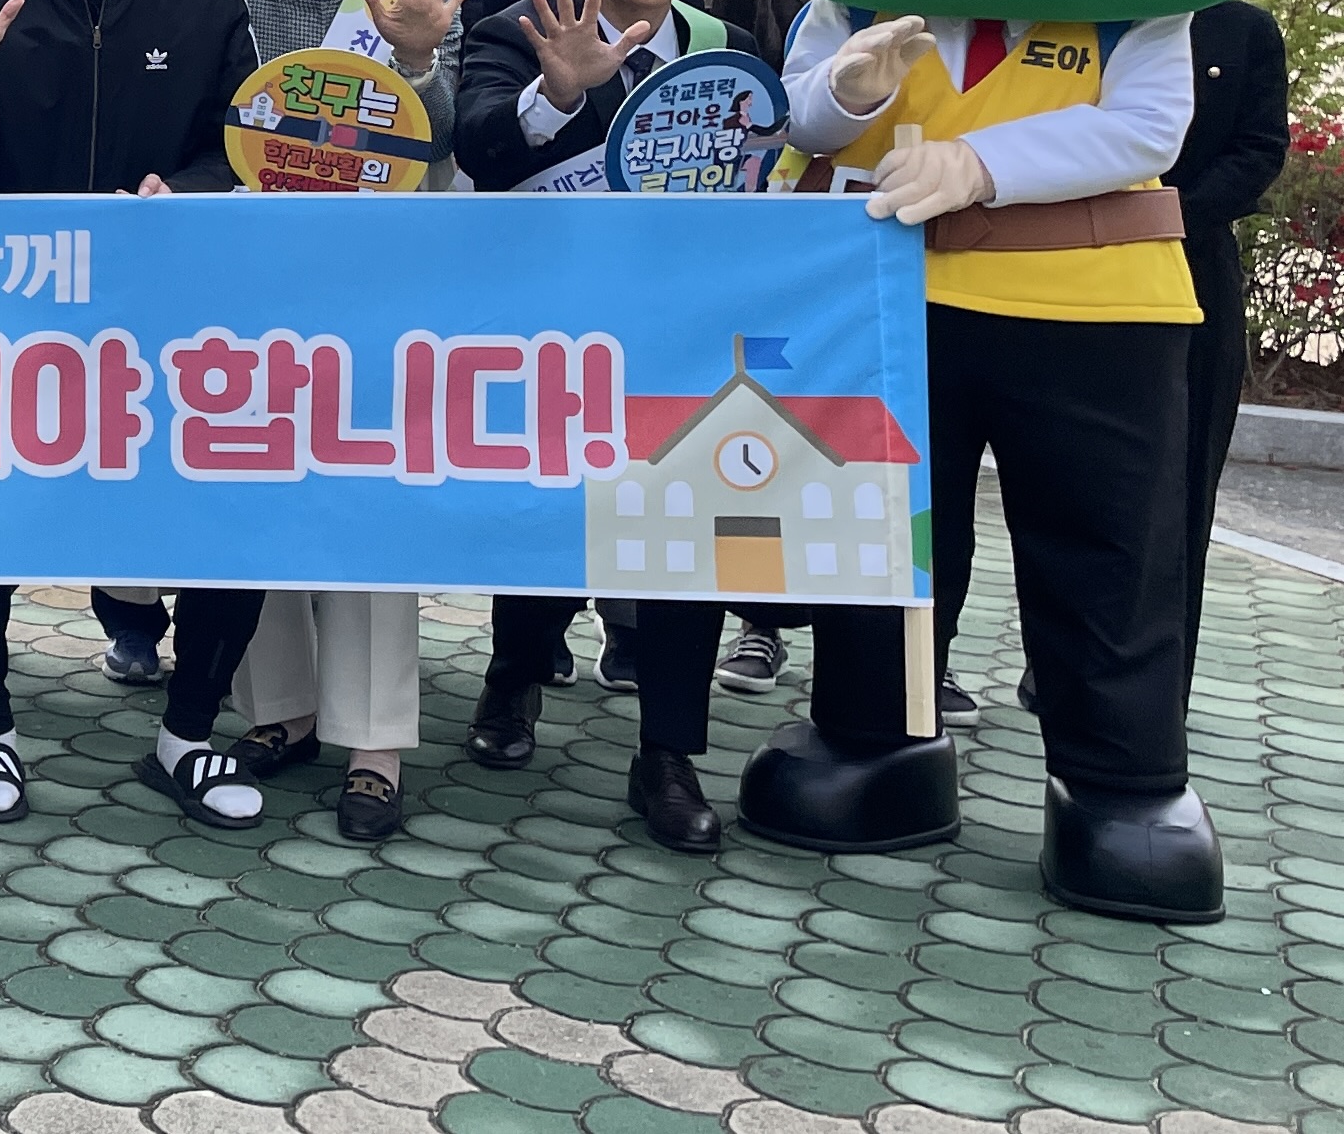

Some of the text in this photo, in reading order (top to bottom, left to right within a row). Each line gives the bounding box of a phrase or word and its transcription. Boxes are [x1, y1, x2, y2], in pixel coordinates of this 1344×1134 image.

[1020, 40, 1091, 74] 도아
[280, 64, 399, 128] 친구는
[659, 77, 738, 106] 학교폭력
[633, 103, 722, 135] 로그아웃
[263, 138, 391, 184] 학교생활의
[624, 128, 745, 174] 친구사랑
[172, 334, 624, 478] 합니다!
